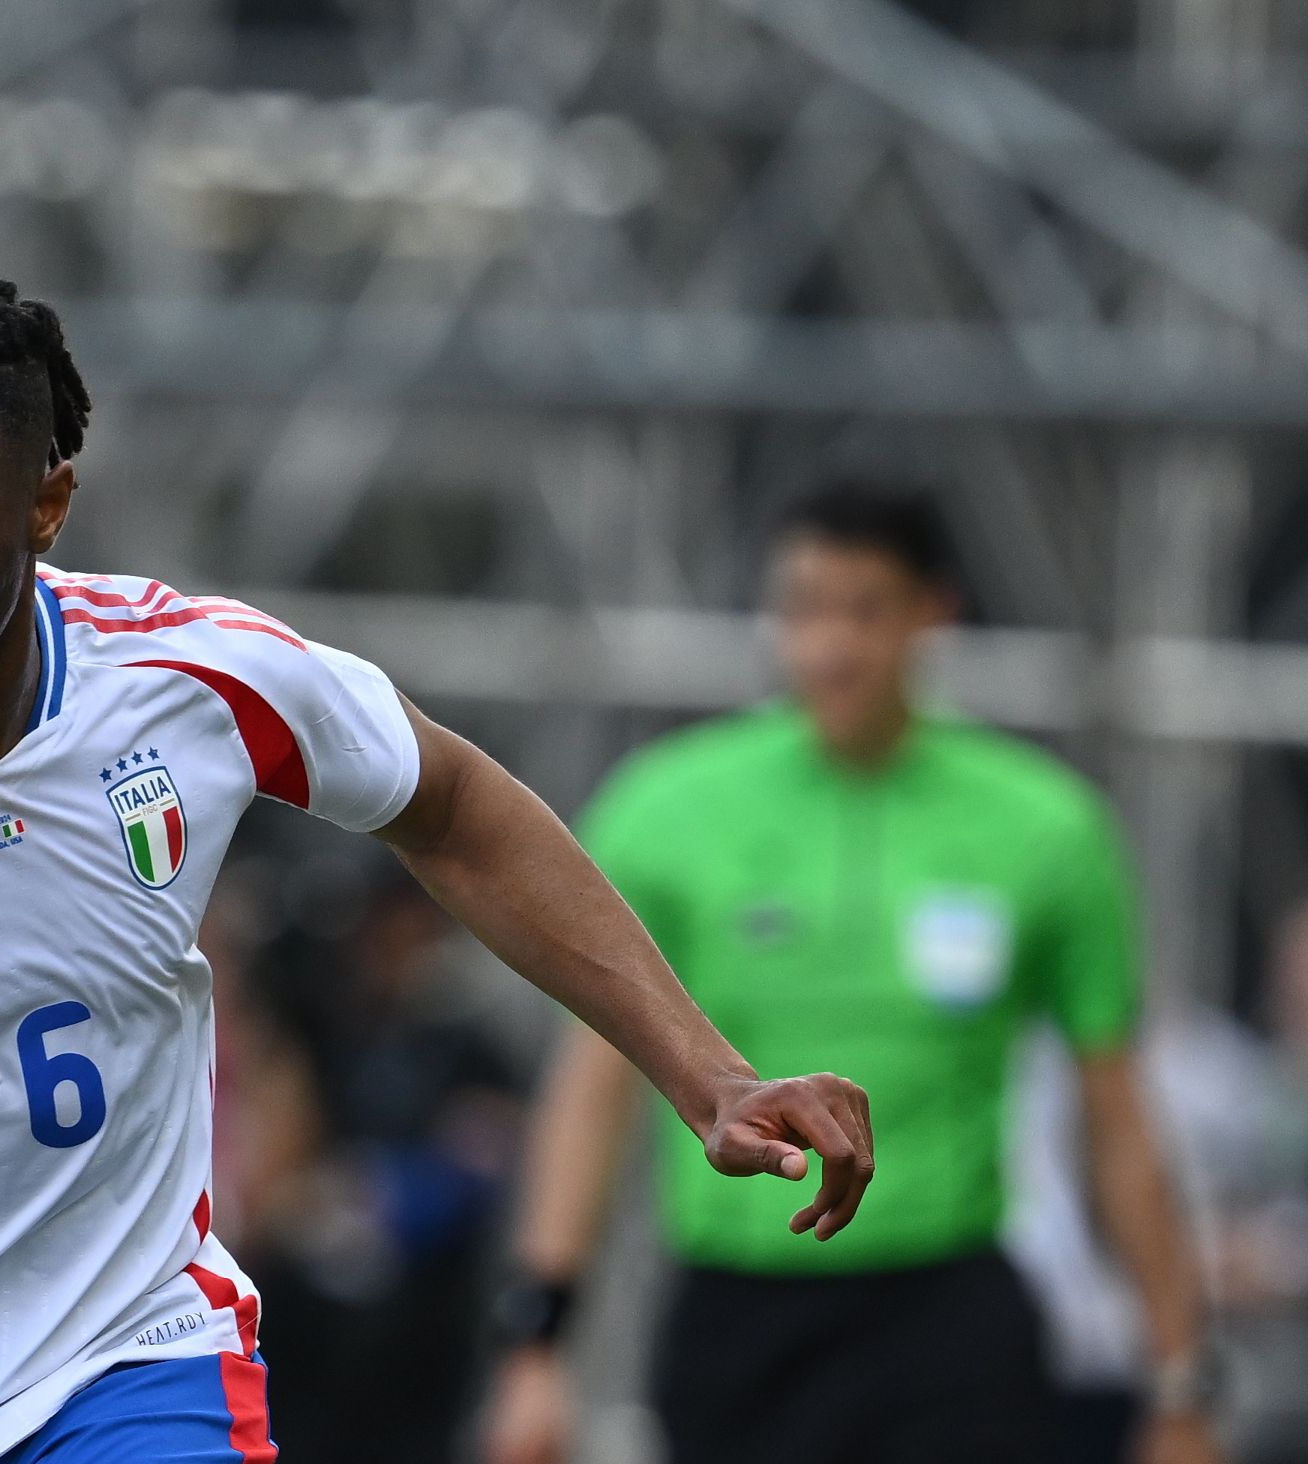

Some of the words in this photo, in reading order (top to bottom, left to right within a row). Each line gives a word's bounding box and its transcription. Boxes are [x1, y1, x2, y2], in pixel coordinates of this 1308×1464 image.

[114, 776, 172, 814] ITALIA
[142, 803, 159, 817] FIGC
[10, 836, 24, 846] USA
[16, 1000, 106, 1148] 6
[135, 1312, 206, 1346] HEAT.RDY
